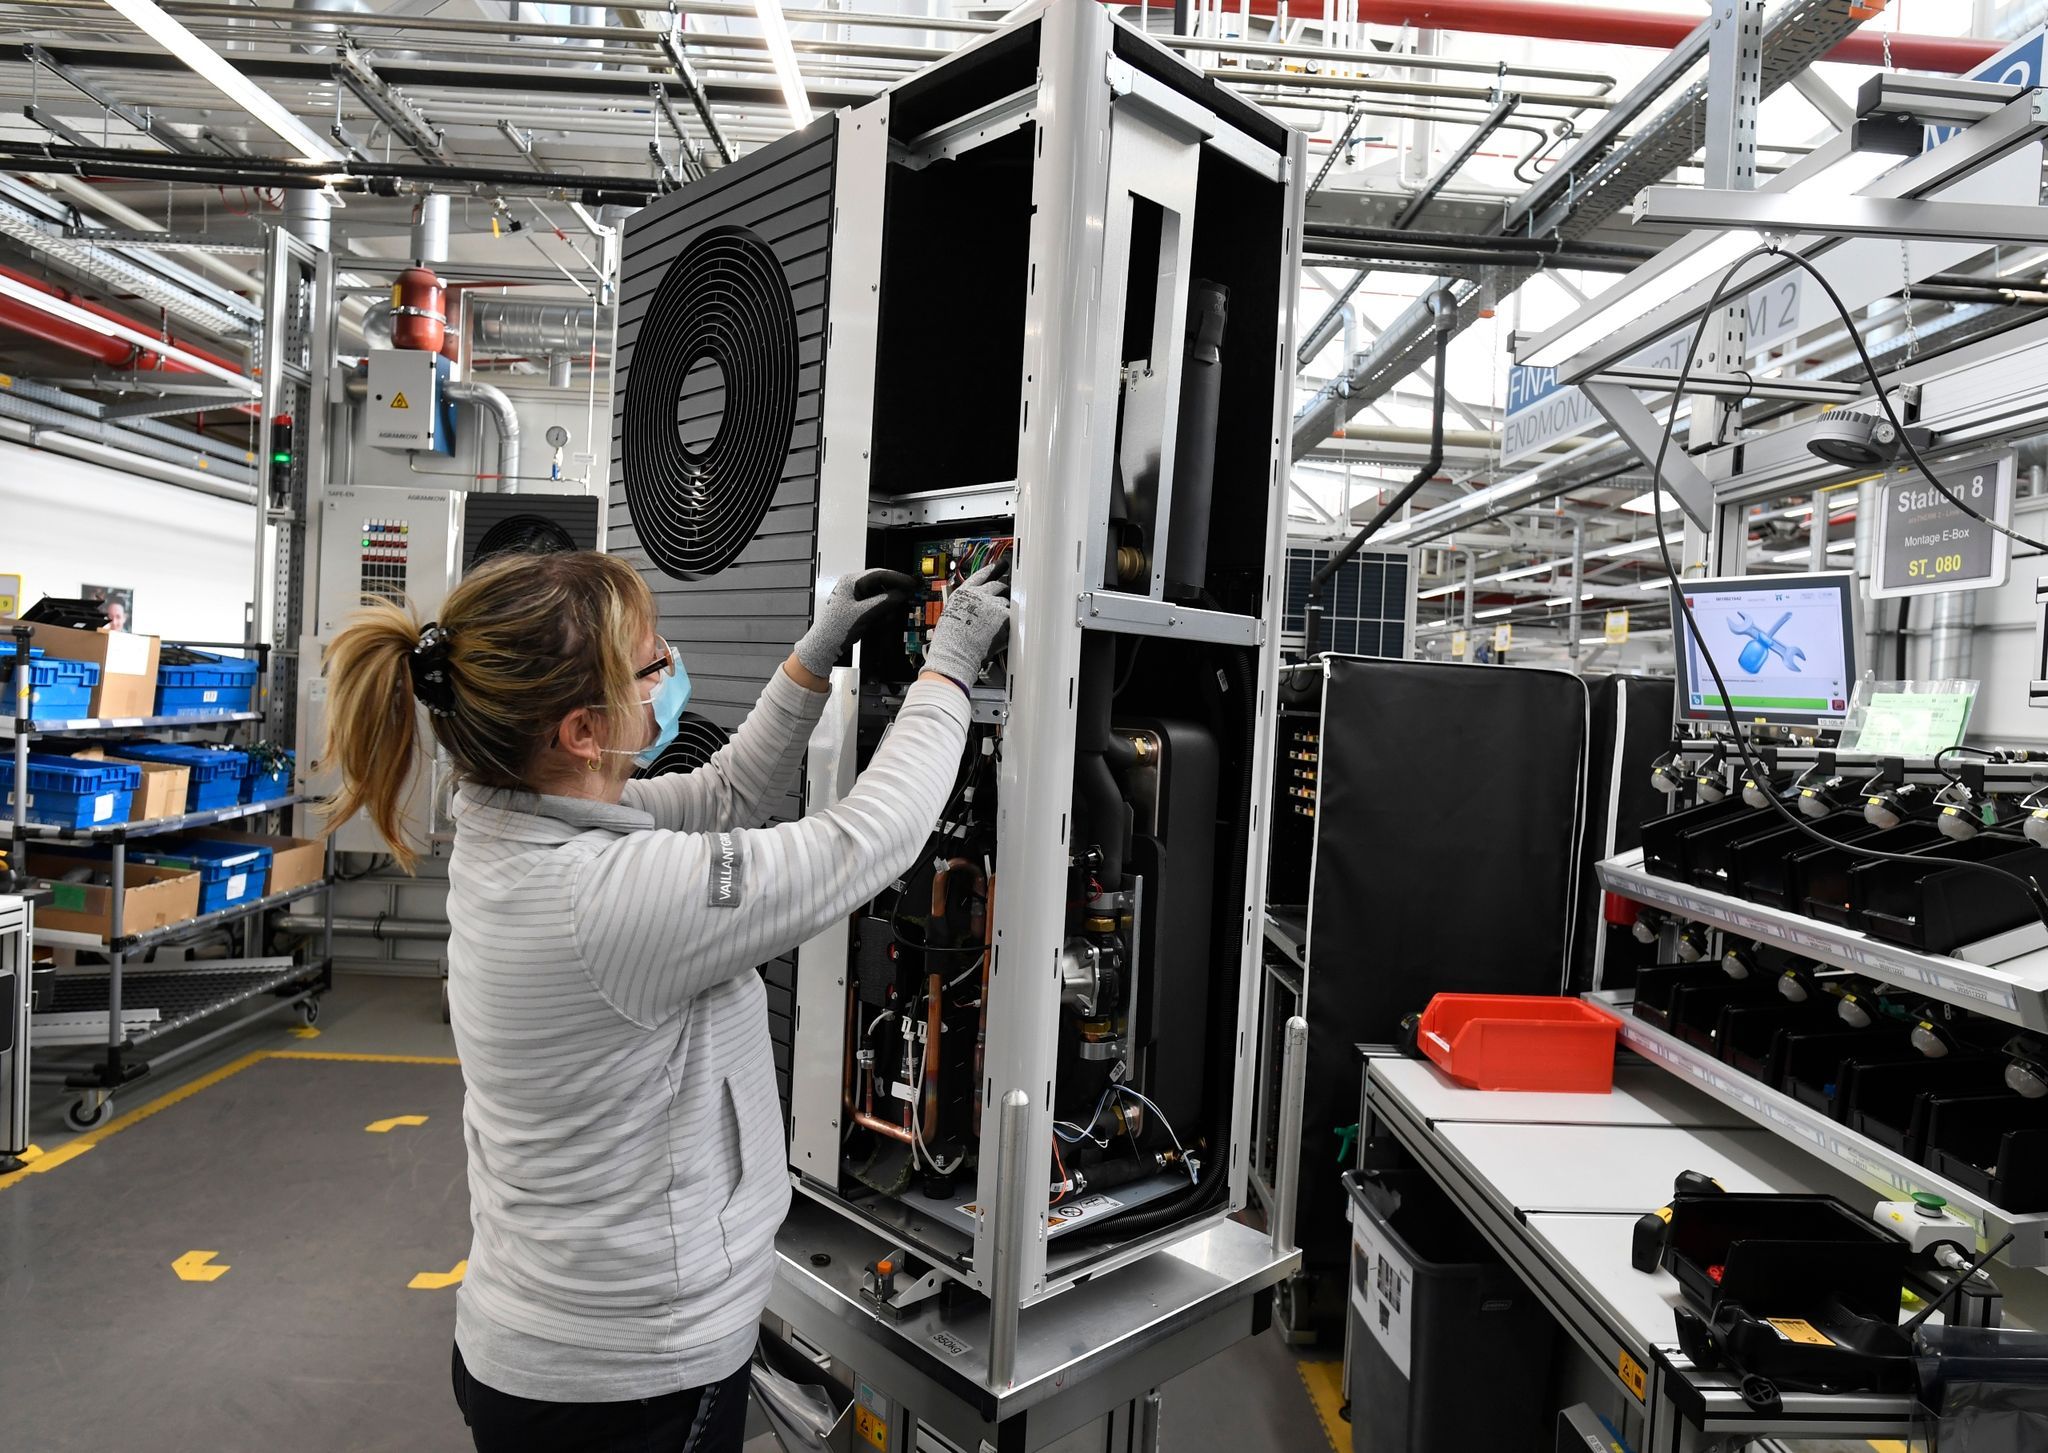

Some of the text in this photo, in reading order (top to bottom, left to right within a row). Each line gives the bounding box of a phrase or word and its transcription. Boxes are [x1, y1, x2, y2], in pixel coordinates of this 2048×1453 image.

[1778, 282, 1796, 328] 2
[1971, 475, 1984, 498] 8
[1904, 528, 1970, 548] Montage E-Box
[1908, 554, 1961, 578] ST_080
[933, 1334, 962, 1354] 350kg
